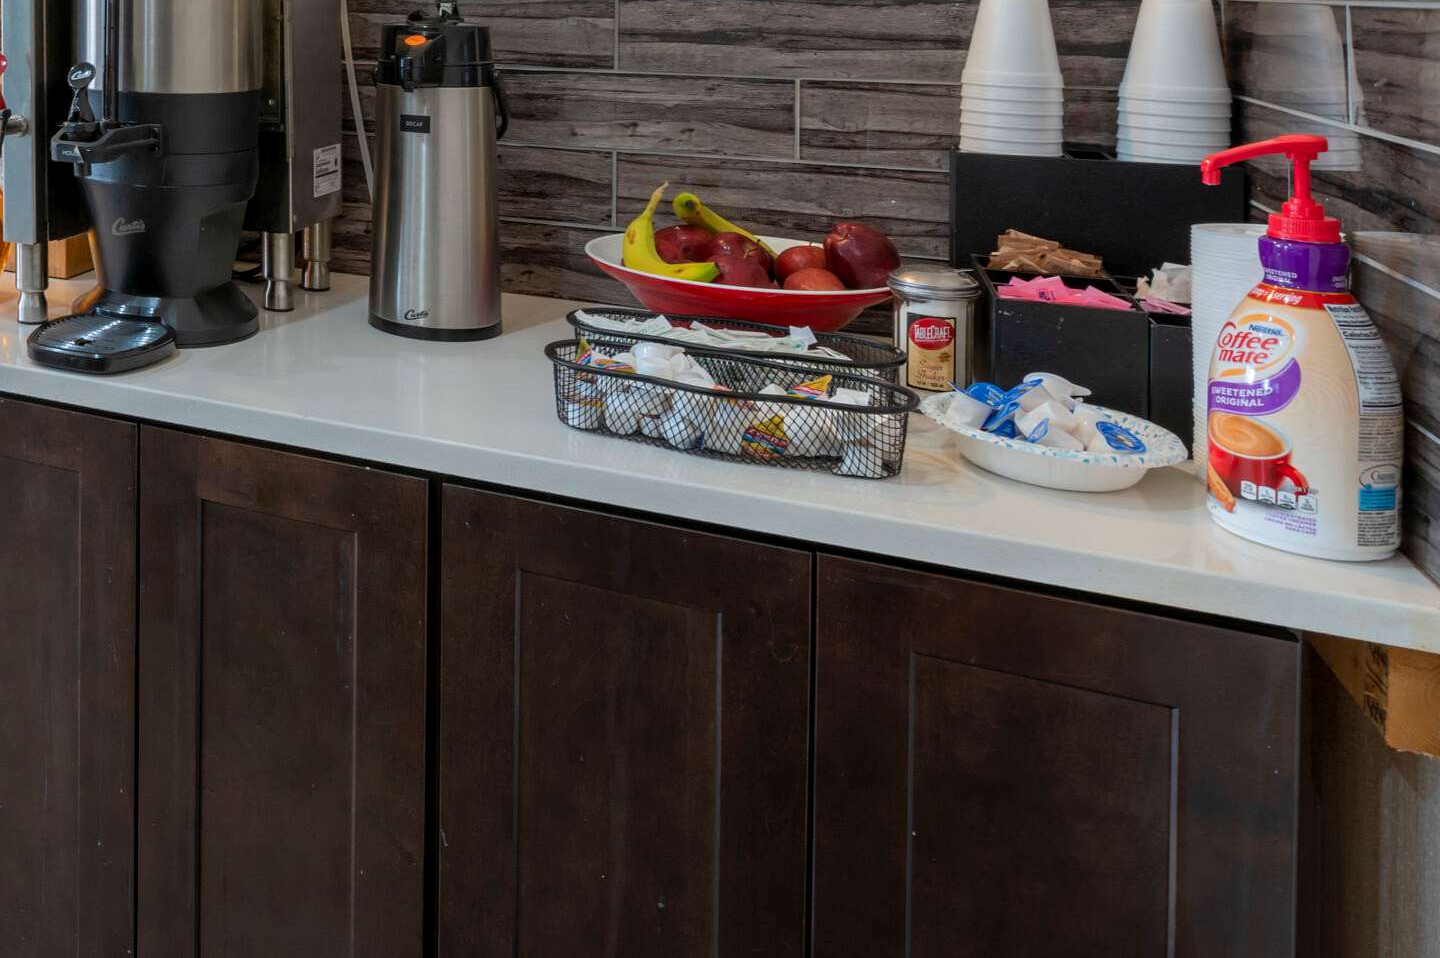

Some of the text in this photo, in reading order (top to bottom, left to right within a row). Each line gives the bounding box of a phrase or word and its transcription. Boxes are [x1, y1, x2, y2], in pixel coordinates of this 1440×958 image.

[1217, 321, 1280, 351] Coffee
[1218, 348, 1269, 364] mate
[1211, 386, 1274, 398] SWEETENED
[1215, 396, 1265, 407] ORIGINAL
